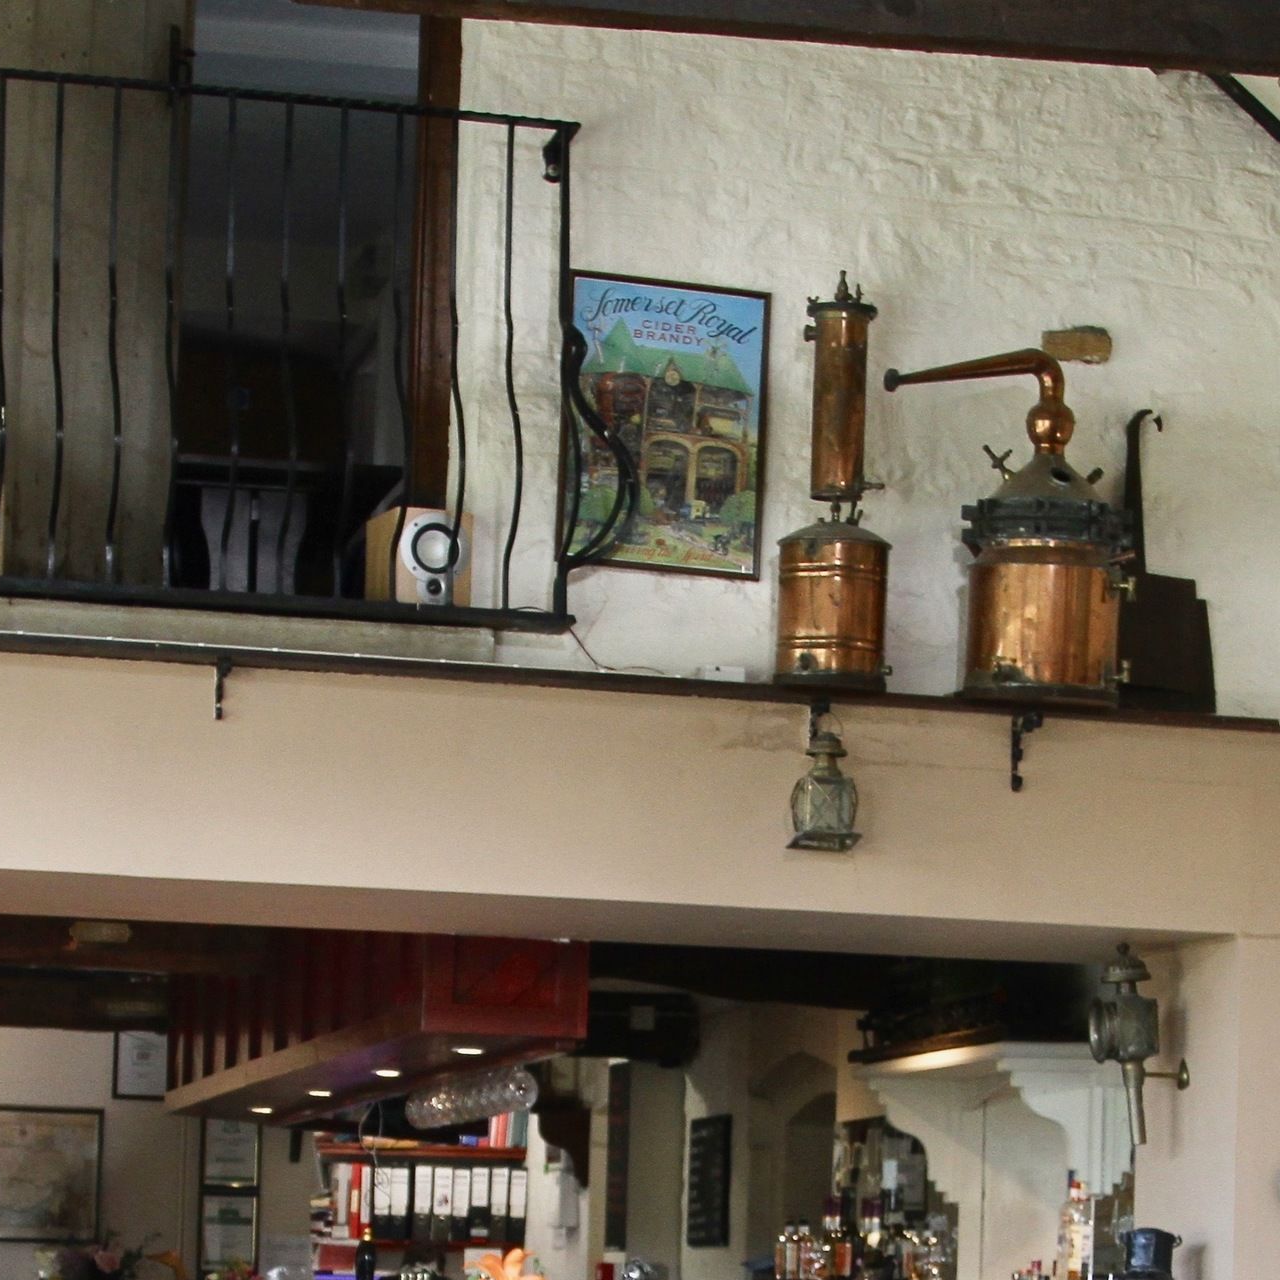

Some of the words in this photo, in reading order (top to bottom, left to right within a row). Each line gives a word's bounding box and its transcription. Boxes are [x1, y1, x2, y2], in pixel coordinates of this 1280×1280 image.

[580, 287, 684, 322] Somerset
[678, 298, 757, 344] Royal
[641, 319, 697, 335] CIDER
[633, 329, 704, 346] BRANDY
